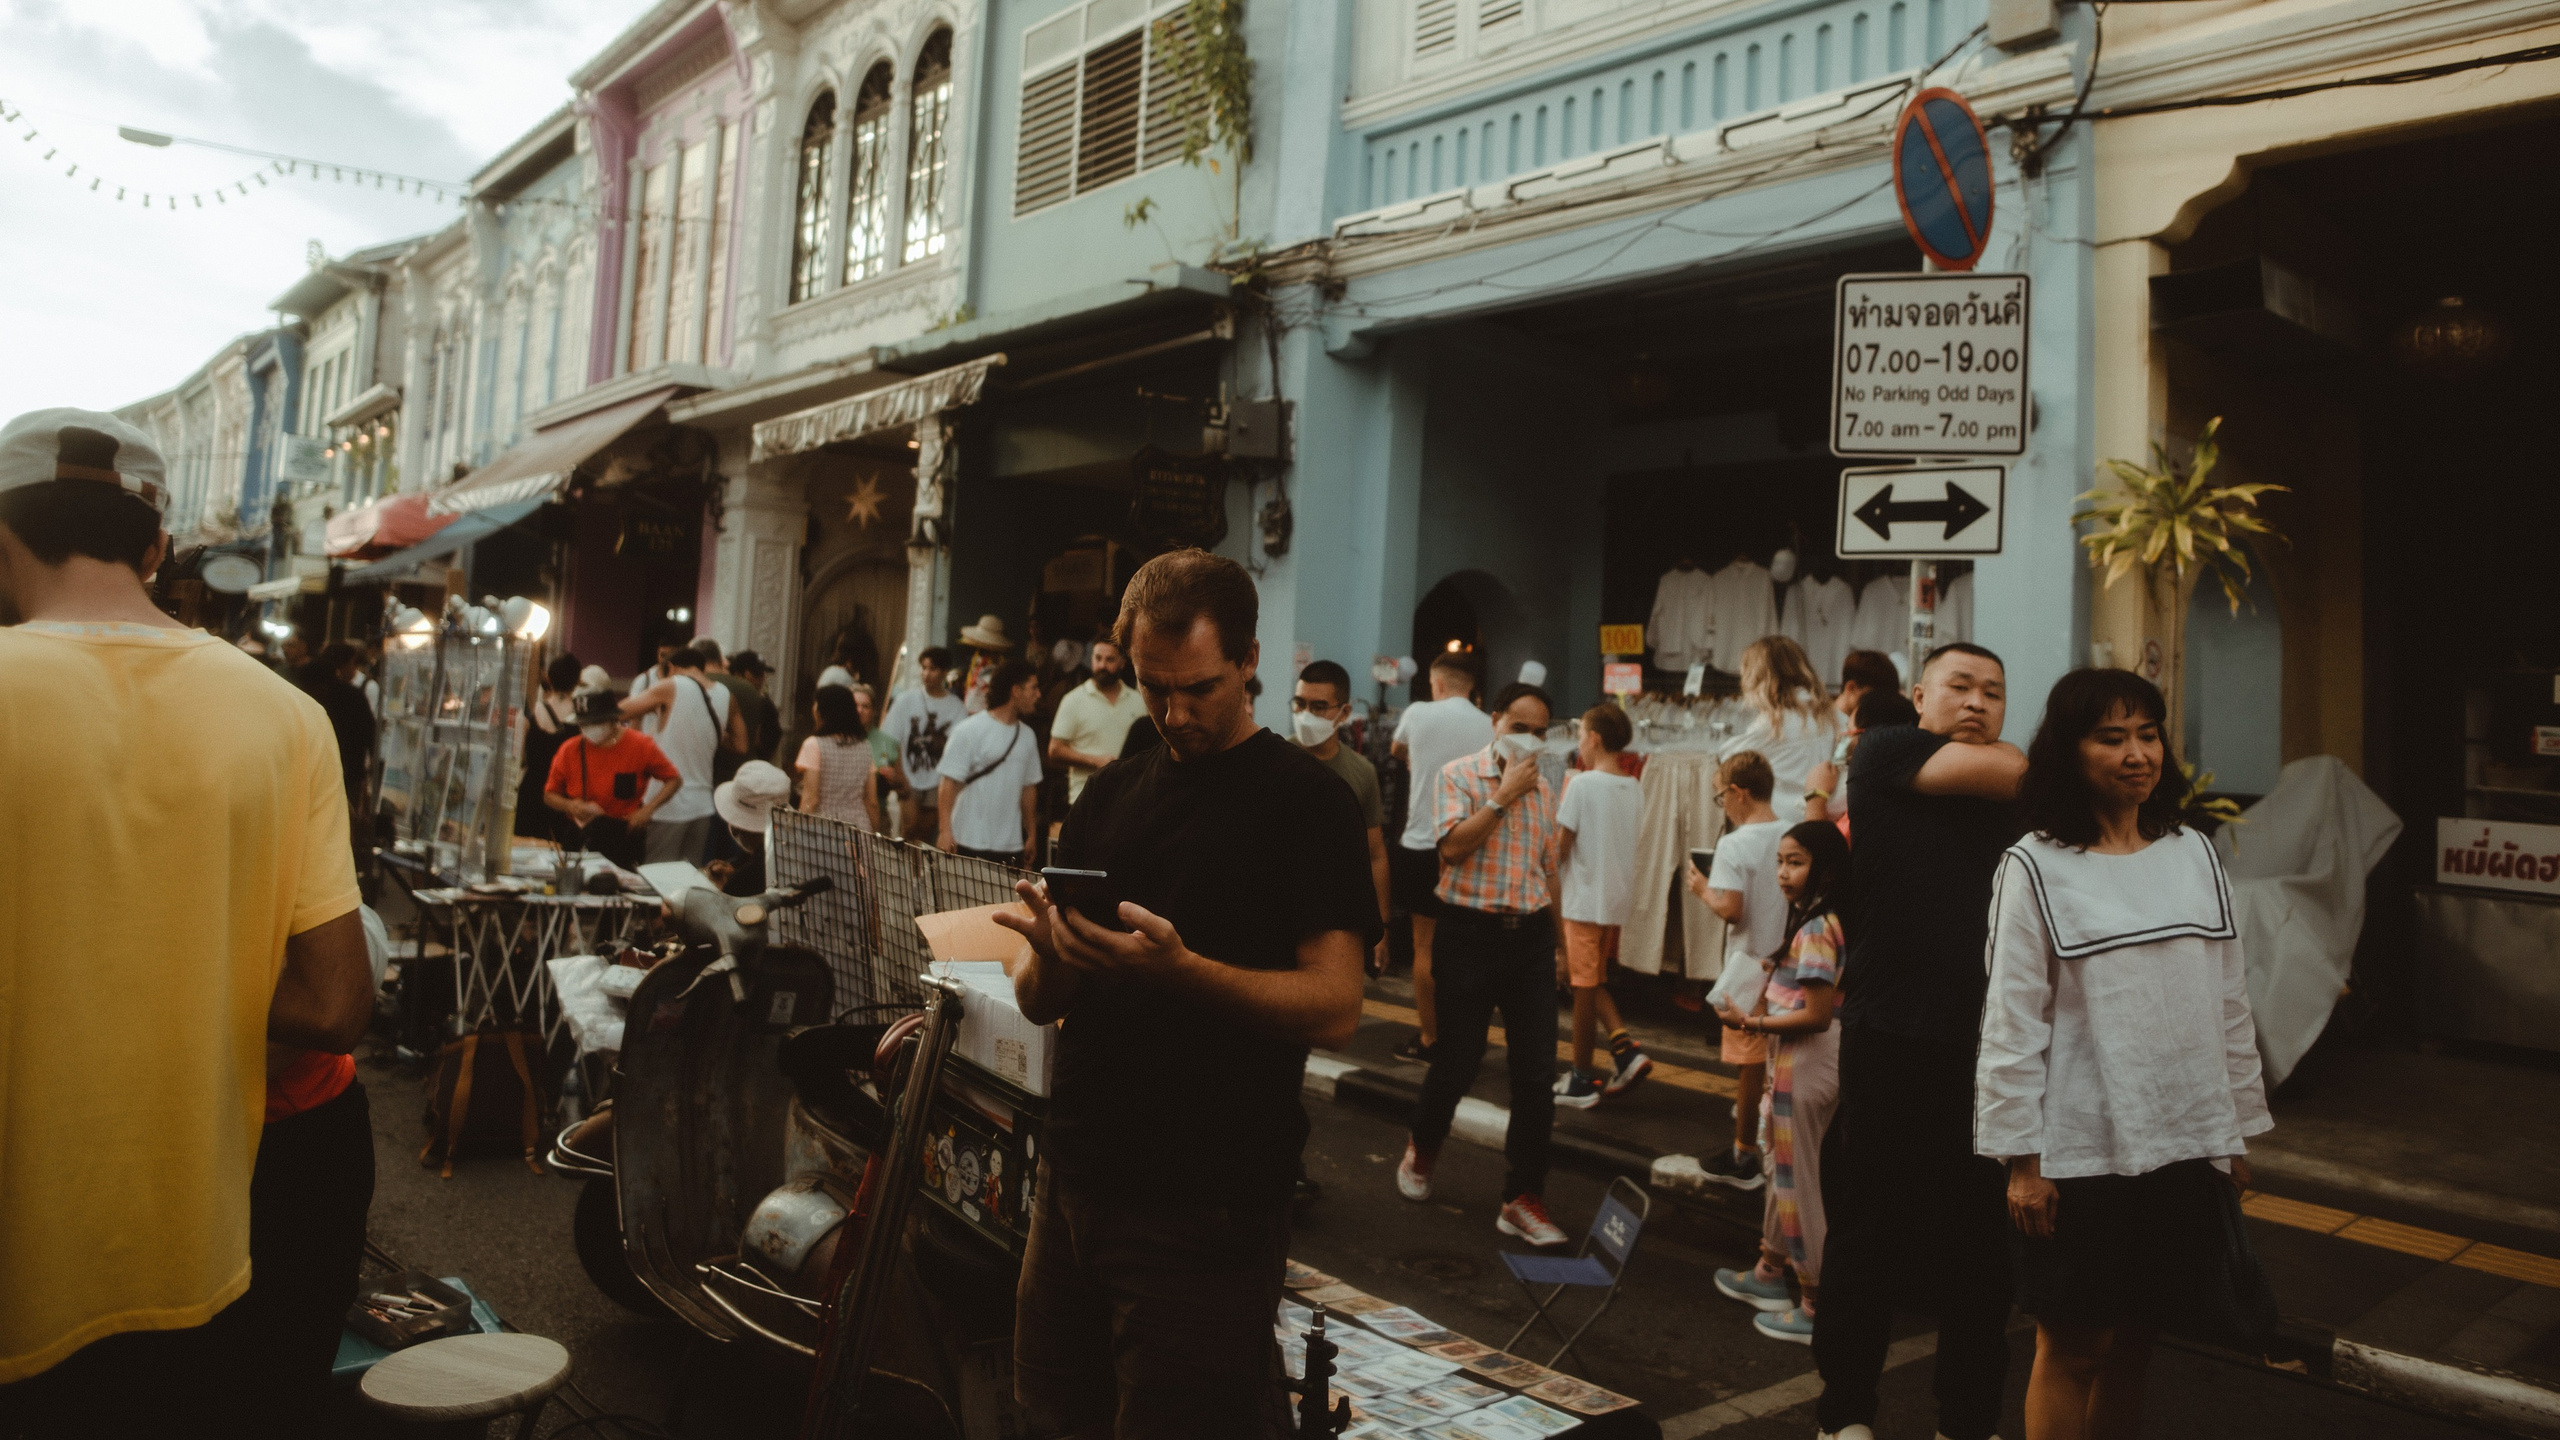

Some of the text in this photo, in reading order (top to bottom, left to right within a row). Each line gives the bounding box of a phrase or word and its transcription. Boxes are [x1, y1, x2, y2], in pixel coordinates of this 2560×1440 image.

[1848, 281, 2022, 328] ห้ามจอดวันคี่
[1845, 385, 2015, 404] No Parking Odd Days
[1845, 413, 1884, 437] 7.00
[1987, 425, 2016, 441] pm
[1605, 627, 1639, 650] 100
